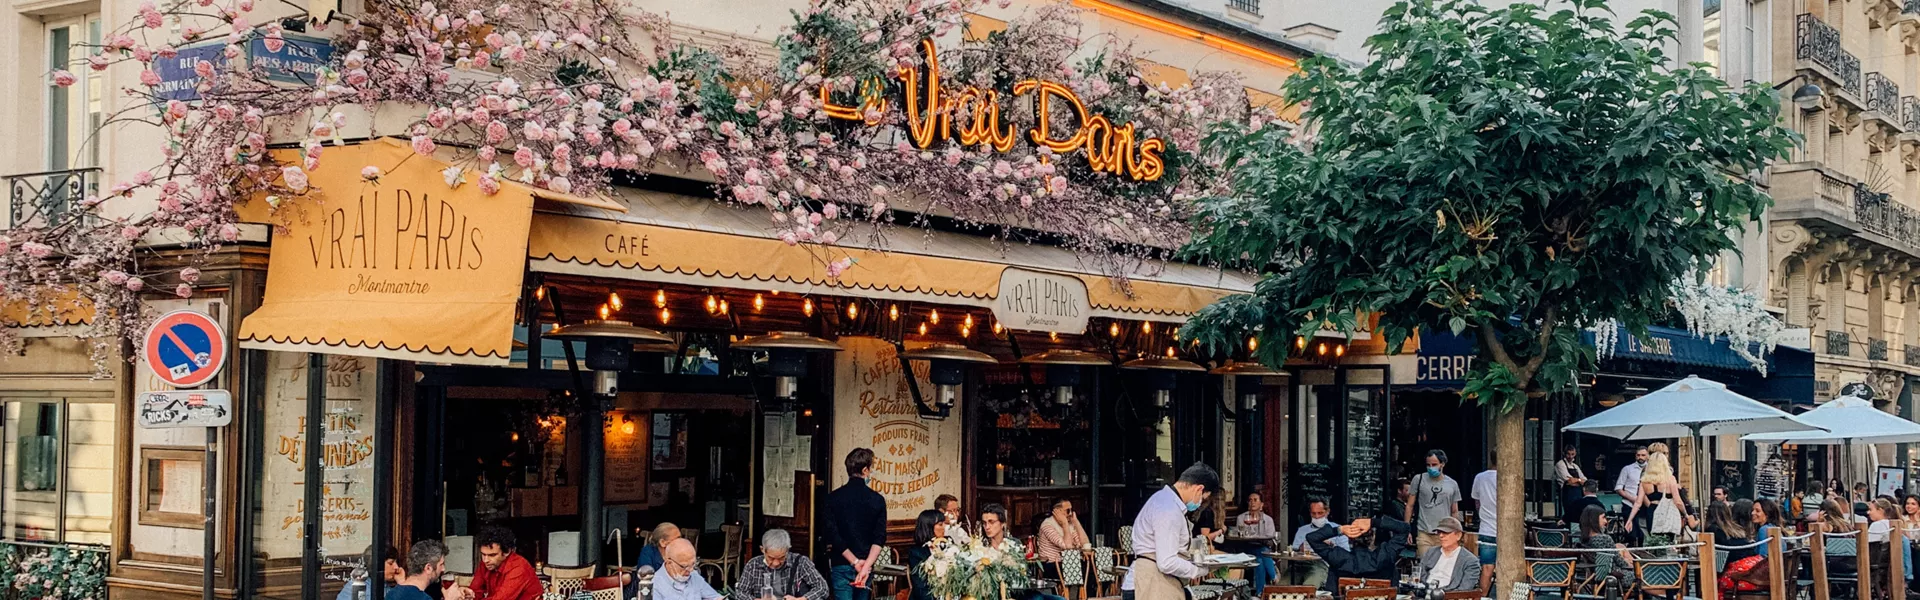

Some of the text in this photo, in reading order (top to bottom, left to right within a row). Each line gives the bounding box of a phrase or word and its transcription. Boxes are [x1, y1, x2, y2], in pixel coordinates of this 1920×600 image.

[288, 45, 318, 58] RUE
[180, 56, 200, 69] RUE
[155, 78, 195, 92] ERMAIN
[898, 38, 1016, 151] Vrai
[309, 189, 484, 271] VRAI PARIS
[605, 234, 649, 256] CAFÉ
[348, 273, 431, 295] Montmartre
[1006, 278, 1079, 318] VRAI PARIS
[1627, 334, 1637, 352] LE
[872, 428, 930, 447] PRODUITS FRAIS
[897, 444, 904, 456] &
[872, 455, 929, 476] FAIT MAISON
[871, 468, 940, 495] TOUTE HEURE
